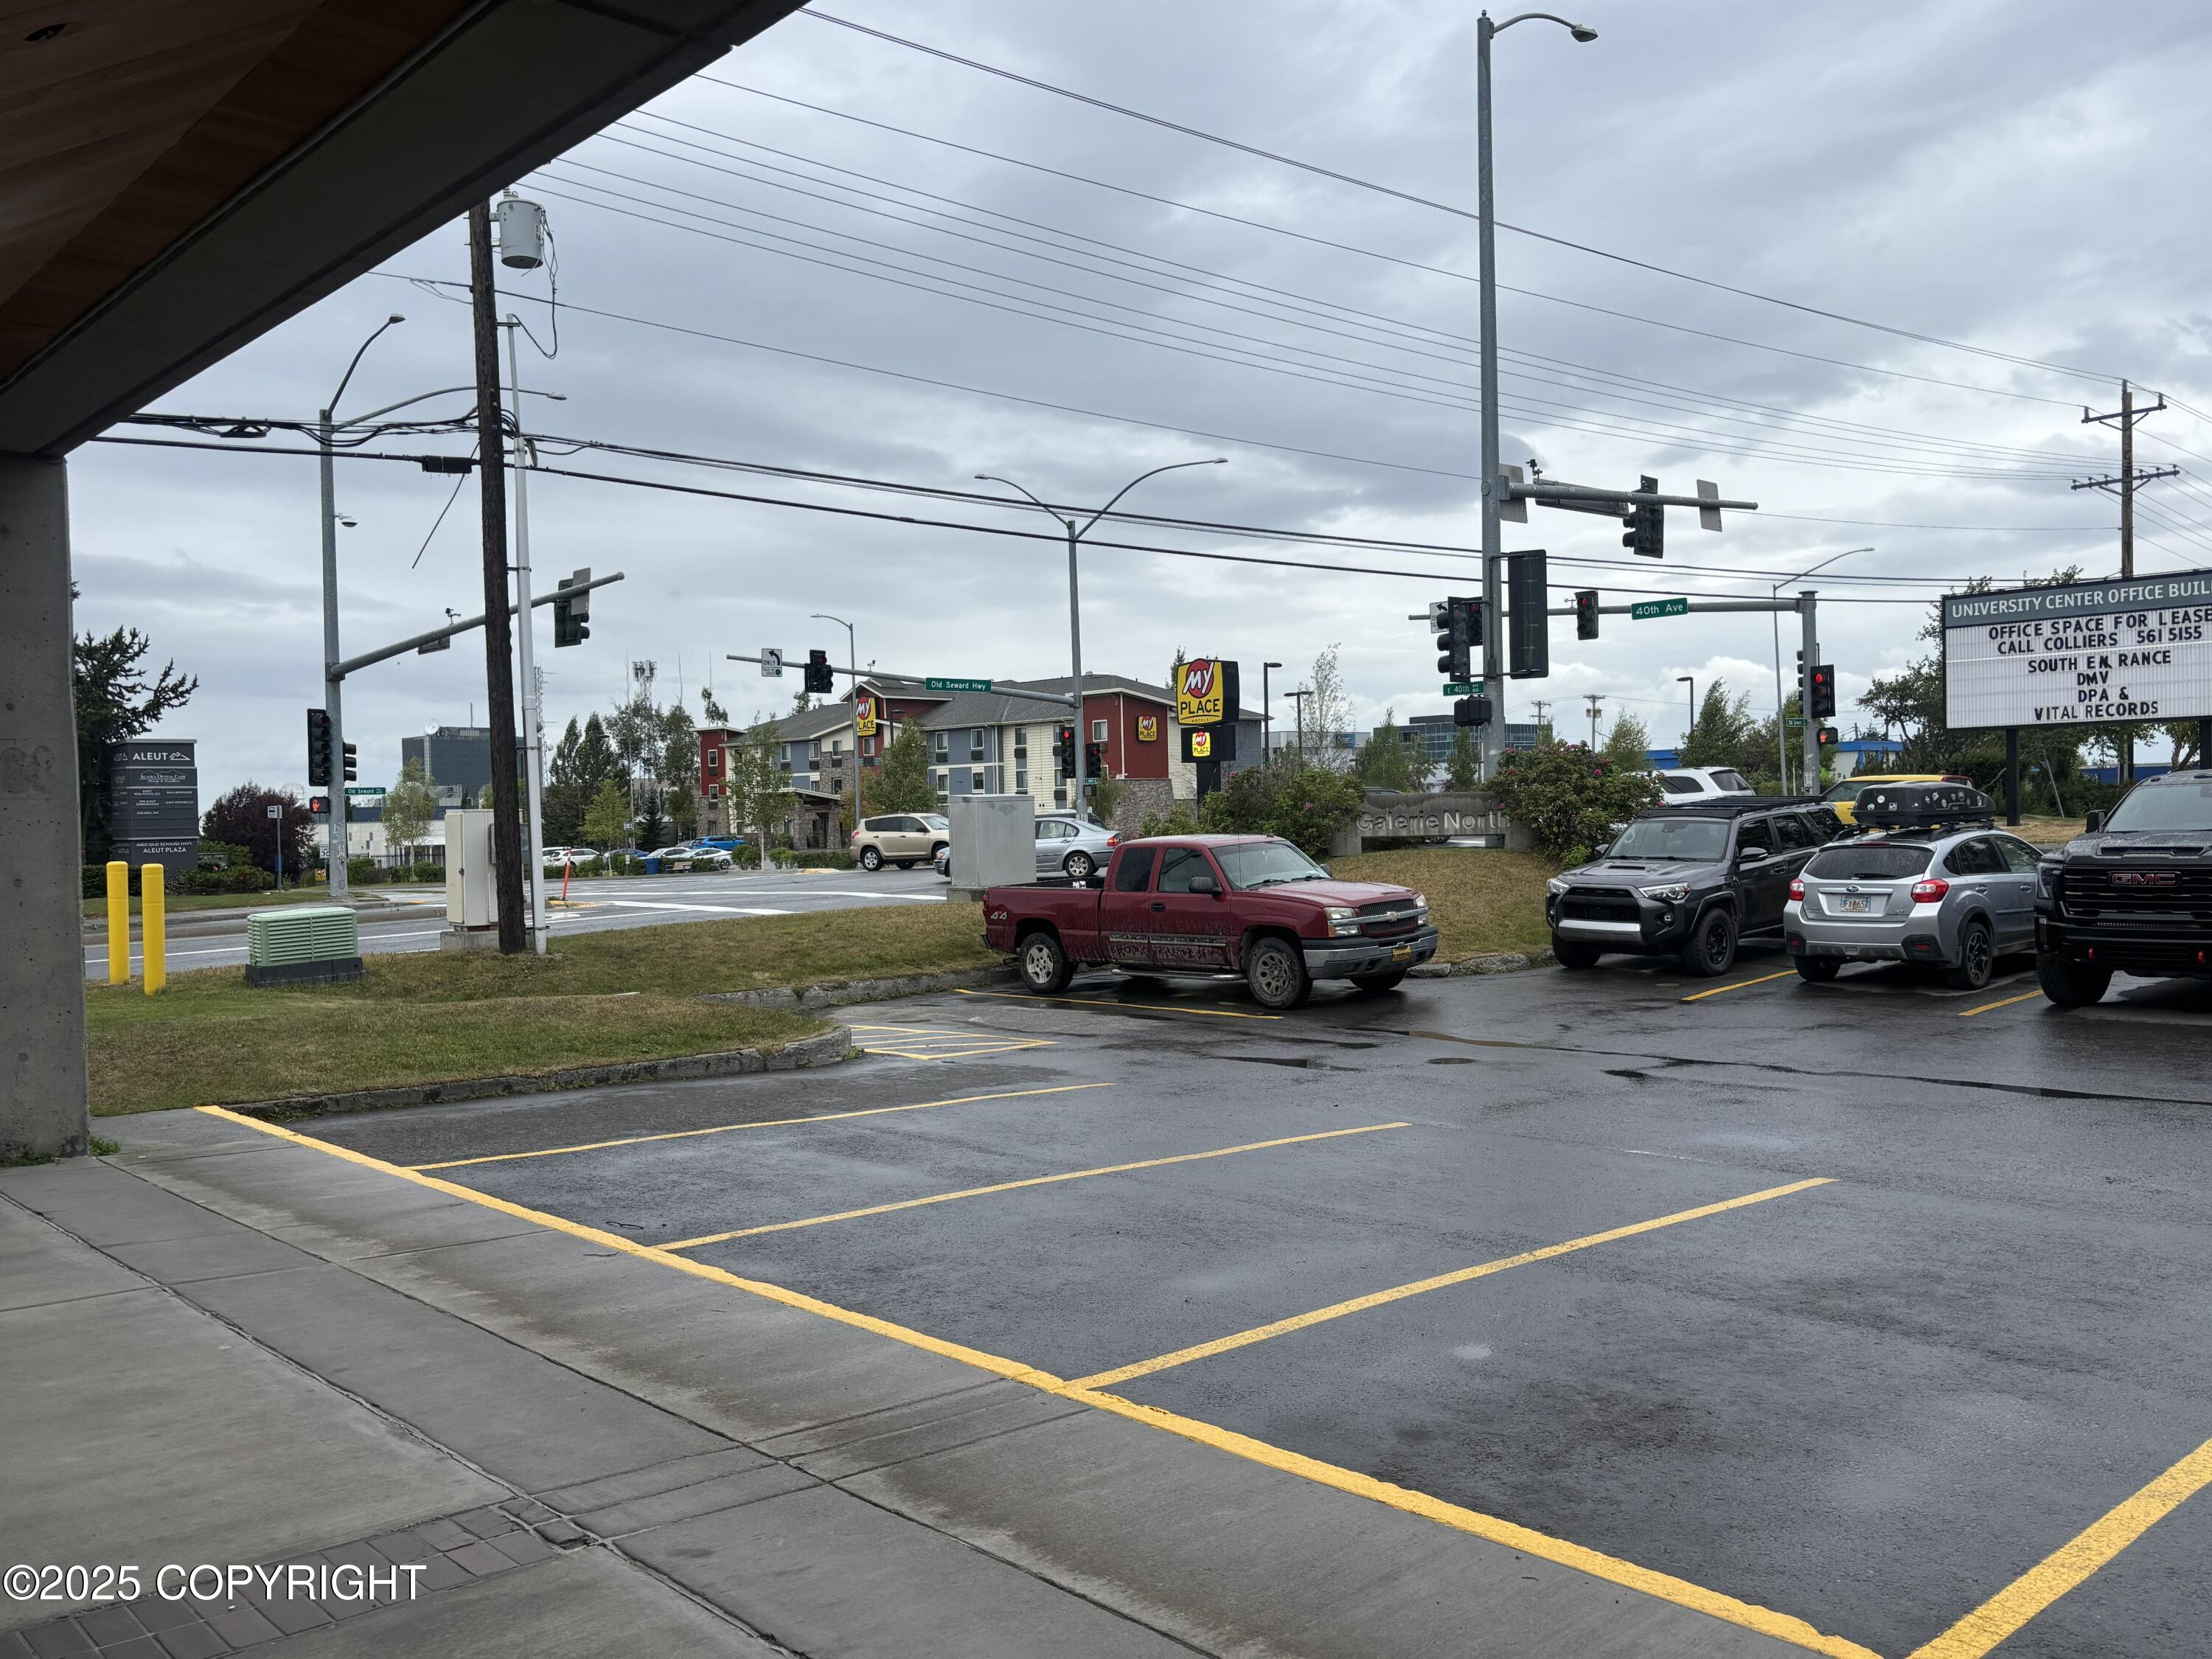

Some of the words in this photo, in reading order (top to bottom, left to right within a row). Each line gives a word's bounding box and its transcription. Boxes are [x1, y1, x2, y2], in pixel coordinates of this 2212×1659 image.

[1952, 597, 2042, 618] UNIVERSITY
[2045, 591, 2104, 610] CENTER
[2108, 585, 2163, 603] OFFICE
[2168, 580, 2212, 598] BUIL
[1635, 605, 1659, 616] 40th
[1665, 603, 1683, 613] Ave
[1989, 623, 2043, 640] OFFICE
[2051, 618, 2104, 635] SPACE
[2114, 613, 2148, 630] FOR
[2159, 608, 2212, 626] LEASE
[1997, 639, 2035, 655] CALL
[2044, 632, 2118, 651] COLLIERS
[2137, 628, 2162, 644] 561
[2168, 625, 2202, 641] 5155
[2028, 657, 2078, 673] SOUTH
[945, 681, 969, 689] Seward
[972, 682, 986, 691] Hwy
[2077, 670, 2109, 686] DMV
[1454, 685, 1470, 694] 40th
[2078, 688, 2109, 703] DPA
[2118, 686, 2129, 700] &
[1180, 698, 1220, 715] PLACE
[2034, 705, 2078, 721] VITAL
[2085, 700, 2158, 718] RECORDS
[133, 752, 169, 761] ALEUT
[1356, 810, 1439, 830] Galerie
[1444, 809, 1511, 830] North
[2112, 873, 2177, 886] GMC
